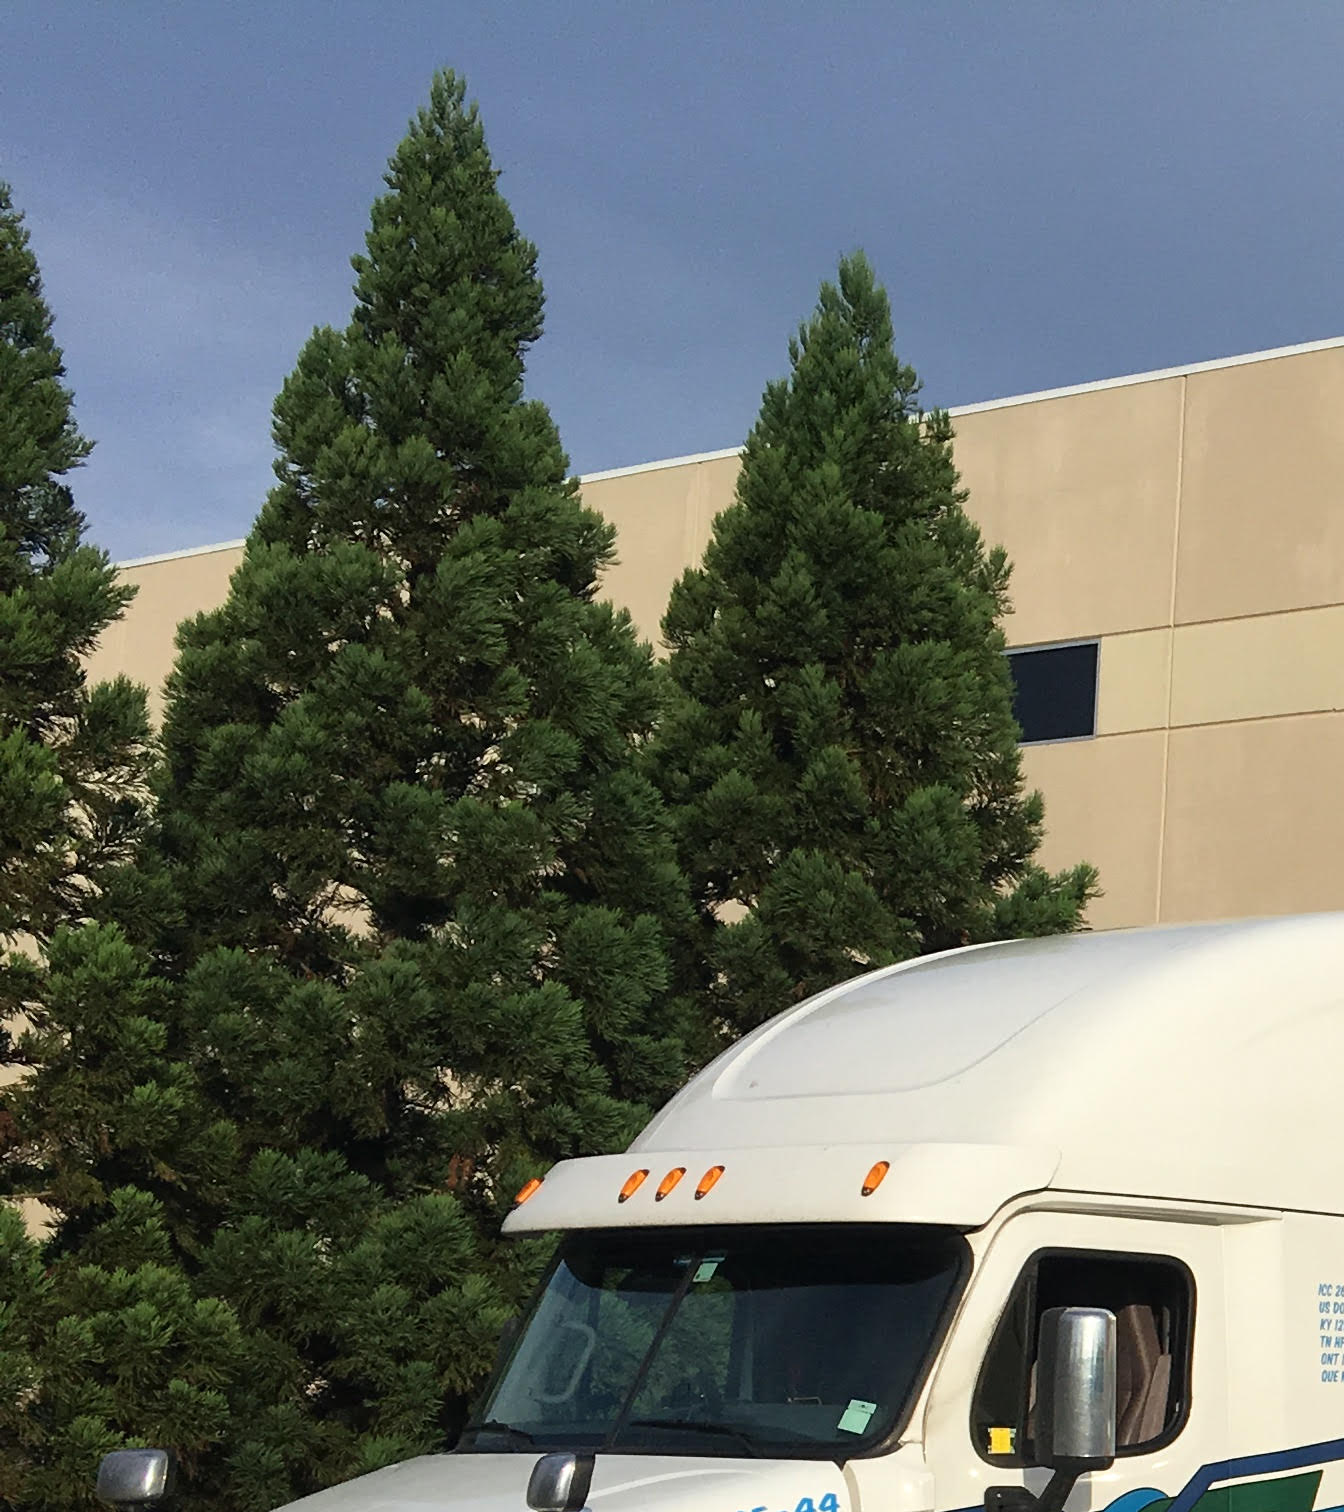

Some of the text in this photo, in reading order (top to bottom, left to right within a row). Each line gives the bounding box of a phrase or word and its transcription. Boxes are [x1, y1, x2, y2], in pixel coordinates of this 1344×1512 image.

[1318, 1284, 1333, 1297] ICC
[1319, 1301, 1331, 1314] US
[1319, 1318, 1333, 1331] KY
[1320, 1336, 1332, 1349] TN
[1321, 1353, 1340, 1366] ONT
[1321, 1369, 1339, 1383] QUE
